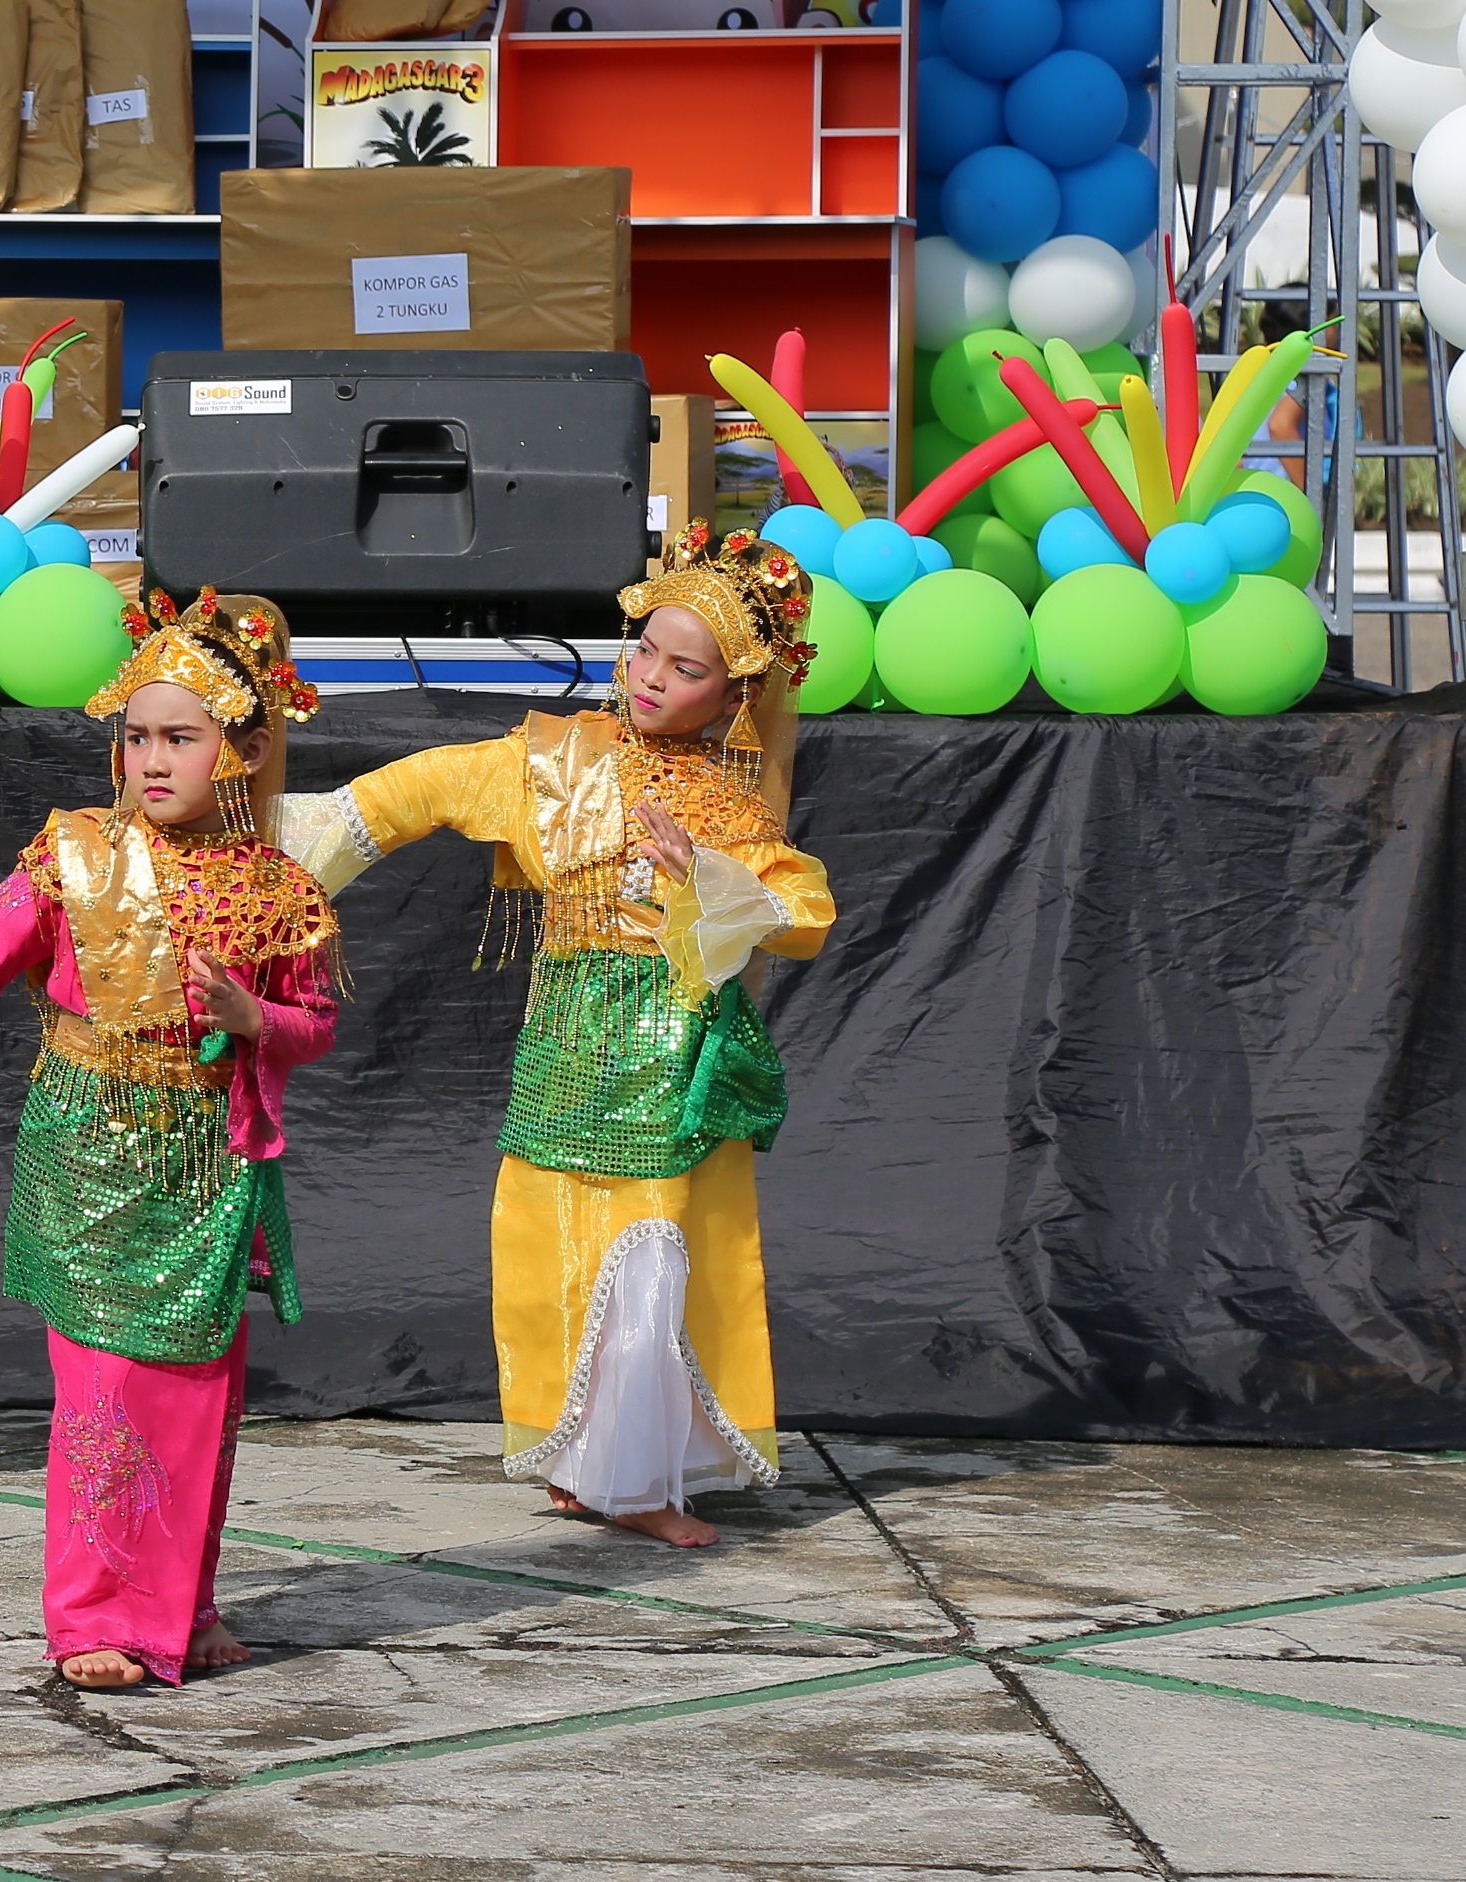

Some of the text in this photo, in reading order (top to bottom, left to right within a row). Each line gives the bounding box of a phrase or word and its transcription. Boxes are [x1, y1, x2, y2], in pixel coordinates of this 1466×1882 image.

[317, 59, 486, 106] MADAGASCAR 3
[102, 98, 132, 113] TAS
[364, 275, 459, 292] KOMPOR GAS
[376, 303, 448, 318] 2 TUNGKU
[244, 385, 286, 399] Sound
